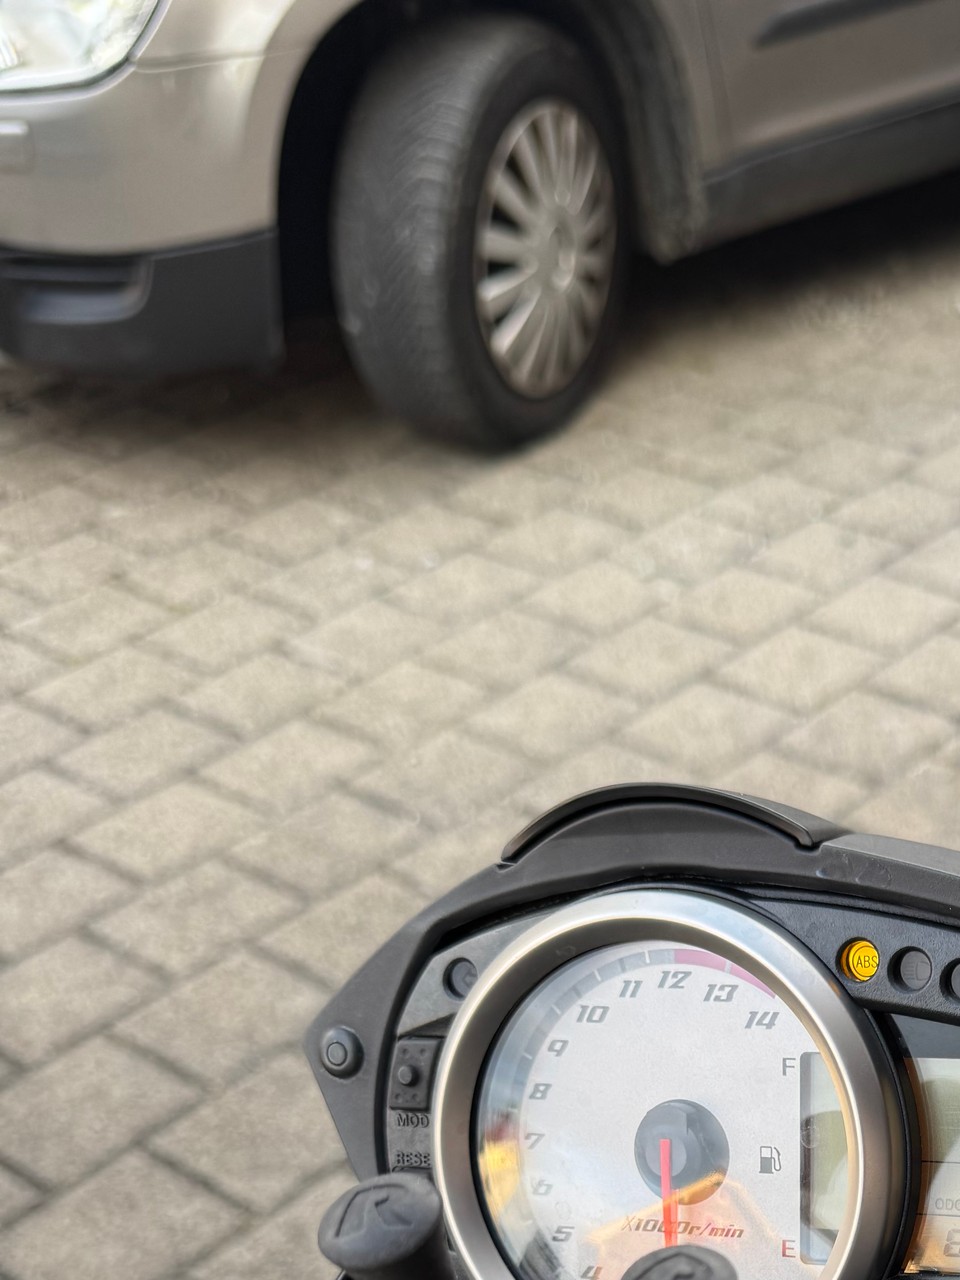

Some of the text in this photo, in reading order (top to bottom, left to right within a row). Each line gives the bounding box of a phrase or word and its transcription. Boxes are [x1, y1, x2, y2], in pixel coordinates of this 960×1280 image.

[856, 955, 878, 969] ABS
[657, 970, 692, 989] 12
[618, 980, 644, 998] 11
[702, 984, 738, 1002] 13
[576, 1005, 609, 1024] 10
[744, 1011, 779, 1030] 14
[547, 1039, 569, 1057] 9
[782, 1057, 796, 1076] F
[528, 1082, 552, 1100] 8
[524, 1132, 545, 1150] 7
[531, 1179, 553, 1196] 6
[551, 1225, 575, 1243] 5
[781, 1239, 796, 1259] E
